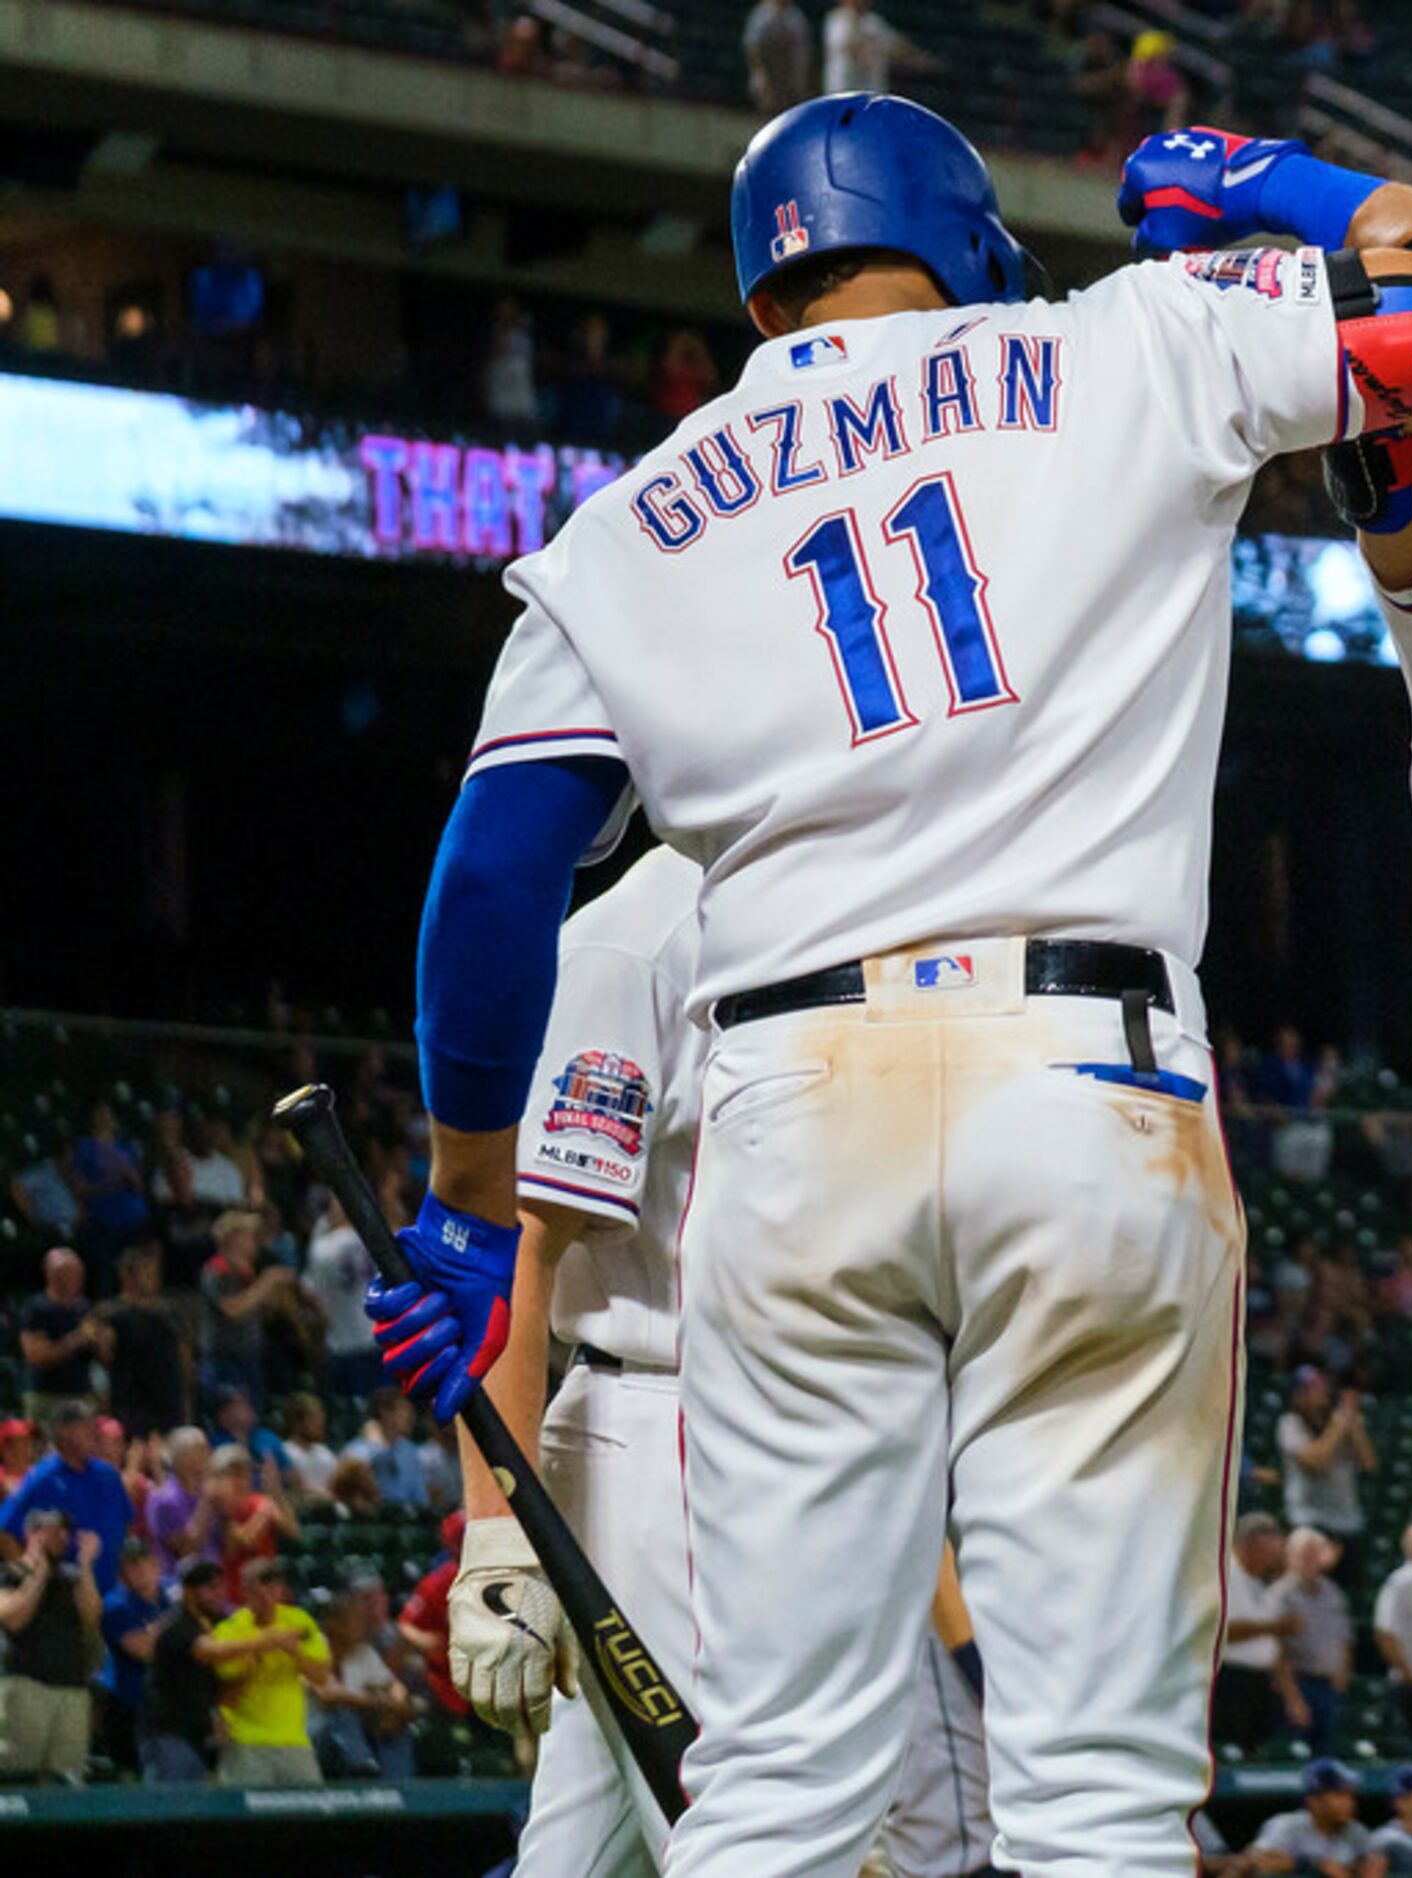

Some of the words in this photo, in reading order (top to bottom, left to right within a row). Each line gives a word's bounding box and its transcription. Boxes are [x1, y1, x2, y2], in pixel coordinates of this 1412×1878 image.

[775, 199, 799, 233] 11
[359, 434, 555, 556] THAT
[631, 316, 1062, 554] GUZMÁN
[783, 470, 1021, 749] 11
[538, 1144, 577, 1165] MLB
[595, 1608, 682, 1727] TUCCI
